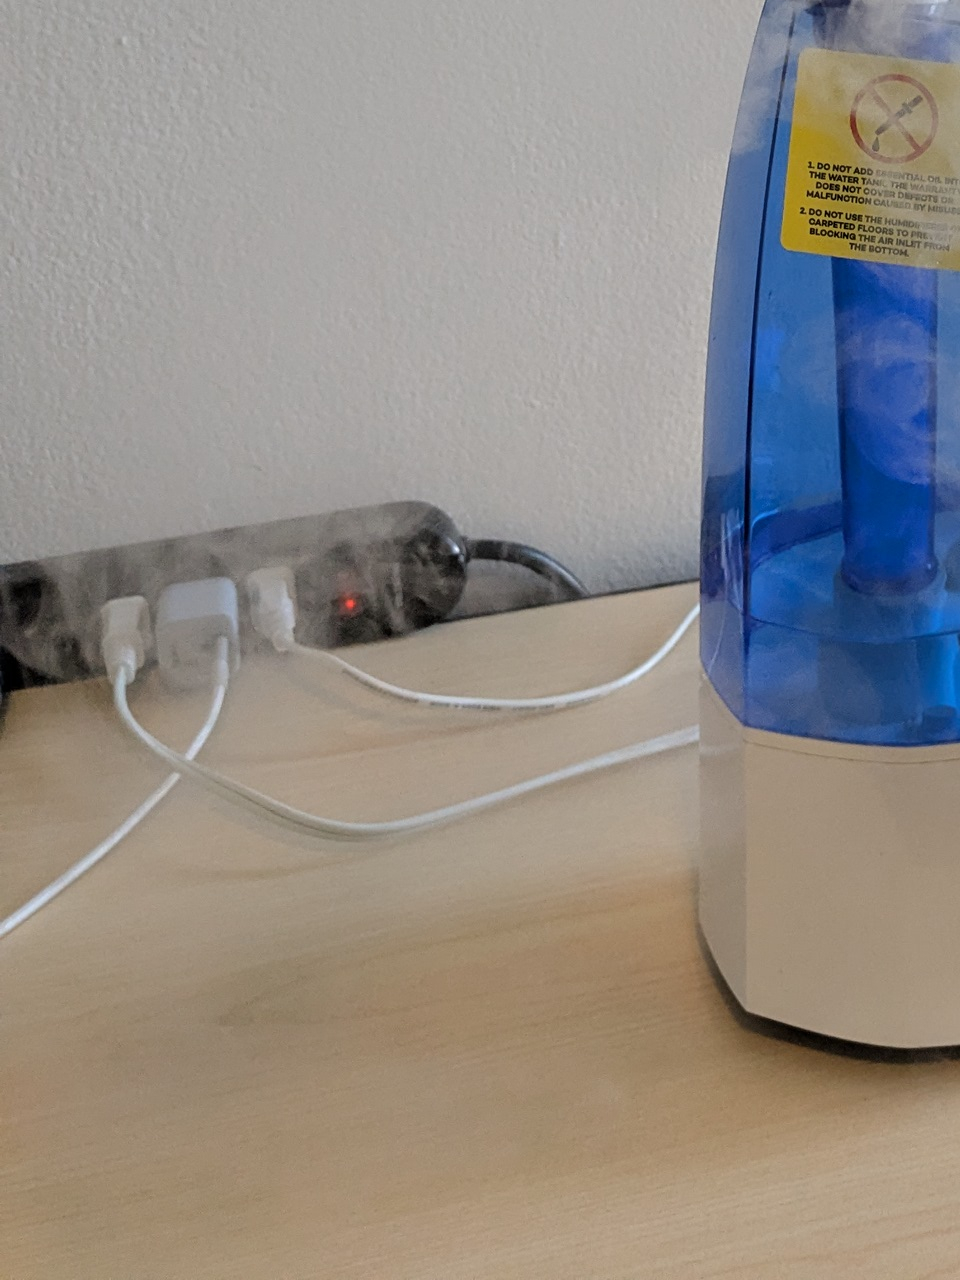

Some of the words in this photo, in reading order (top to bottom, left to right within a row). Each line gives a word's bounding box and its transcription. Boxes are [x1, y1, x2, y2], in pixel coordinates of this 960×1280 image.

[807, 161, 815, 169] 1.
[817, 162, 830, 171] DO
[832, 164, 852, 174] NOT
[853, 166, 873, 176] ADD
[809, 171, 826, 180] THE
[828, 173, 859, 184] WATER
[891, 181, 908, 190] THE
[815, 181, 840, 191] DOES
[842, 185, 861, 194] NOT
[863, 187, 896, 199] COVER
[806, 190, 872, 205] MALFUNCTION
[913, 203, 925, 212] BY
[799, 207, 807, 215] 2.
[808, 208, 822, 217] DO
[824, 210, 844, 220] NOT
[845, 212, 863, 222] USE
[864, 215, 882, 224] THE
[808, 218, 856, 231] CARPETED
[857, 224, 894, 236] FLOORS
[896, 229, 909, 237] TO
[809, 228, 856, 240] BLOCKING
[858, 234, 876, 243] THE
[877, 237, 894, 246] AIR
[895, 239, 922, 249] INLET
[924, 241, 950, 252] FROM
[848, 242, 867, 252] THE
[868, 245, 910, 257] BOTTOM.
